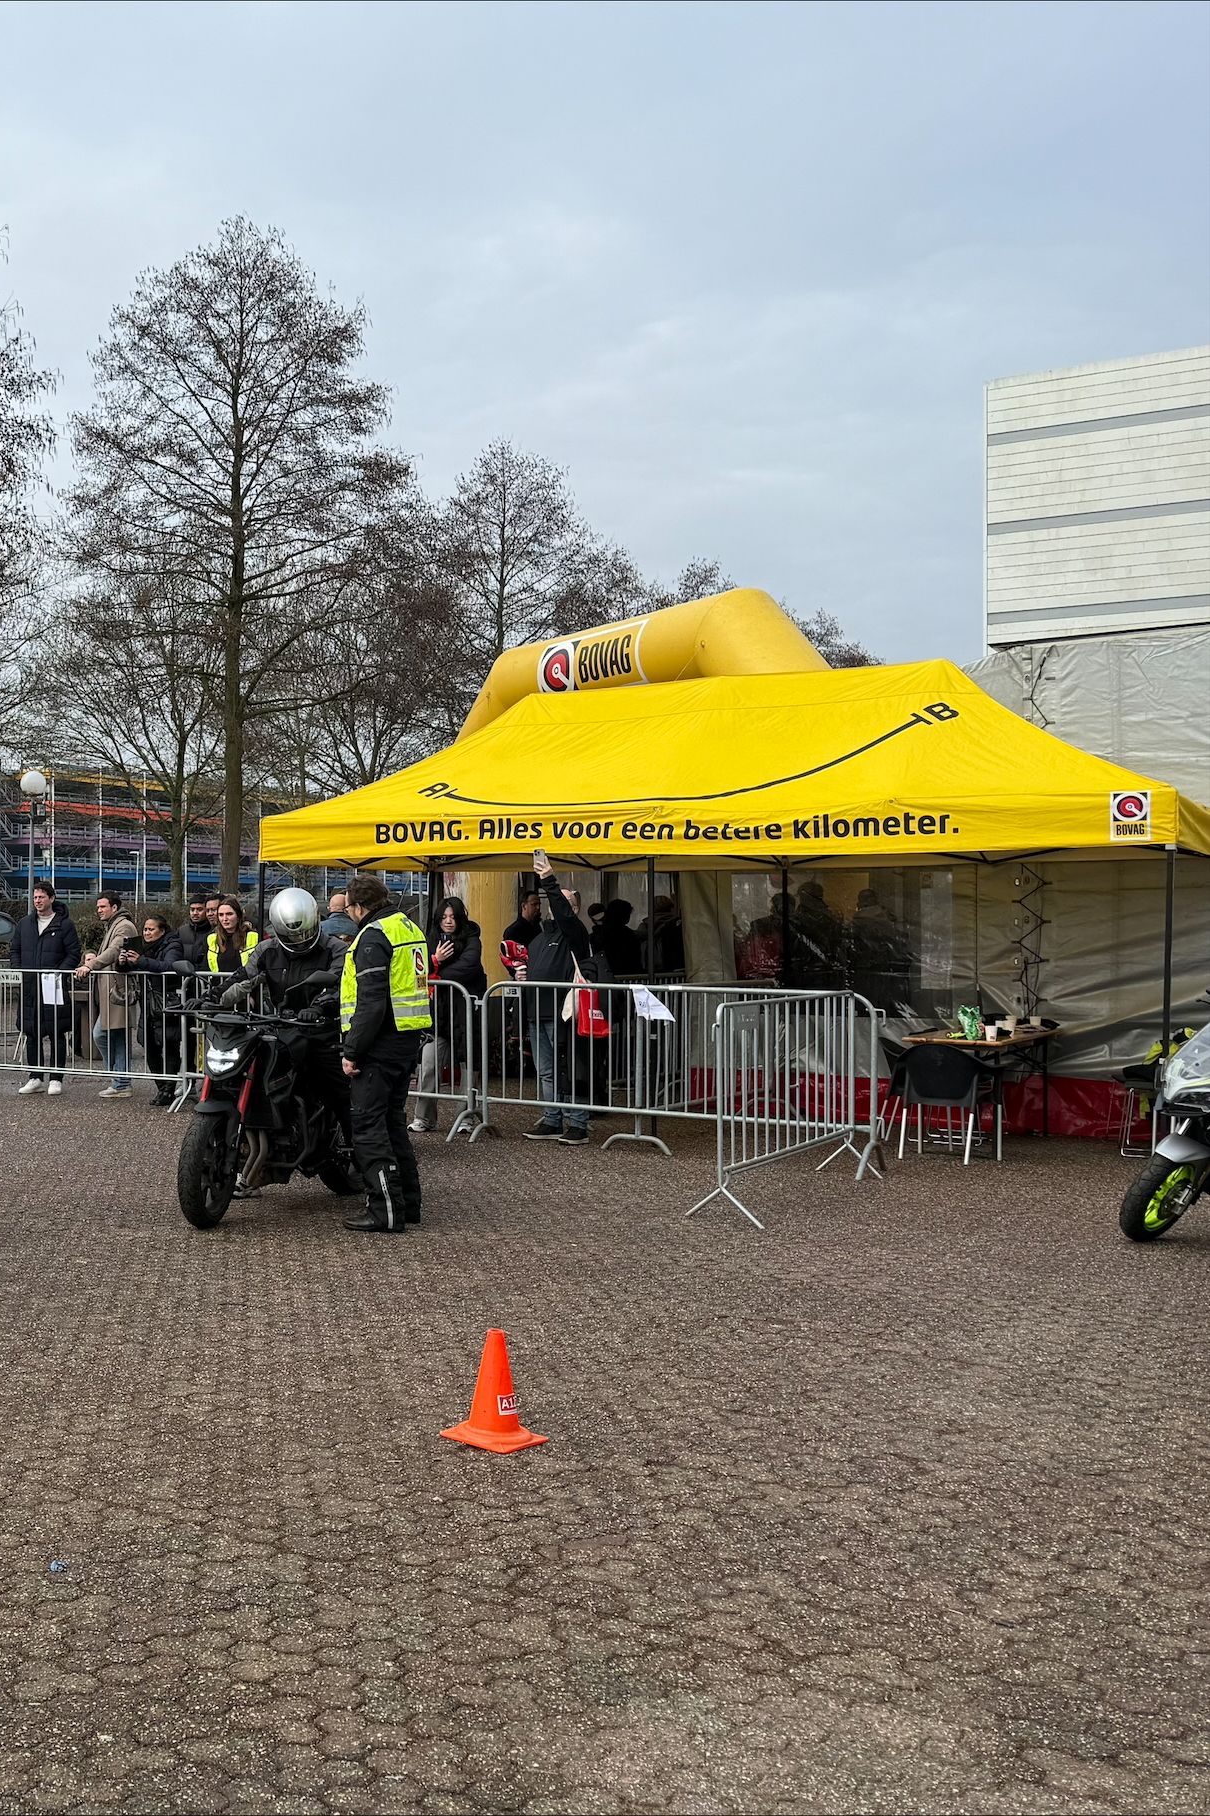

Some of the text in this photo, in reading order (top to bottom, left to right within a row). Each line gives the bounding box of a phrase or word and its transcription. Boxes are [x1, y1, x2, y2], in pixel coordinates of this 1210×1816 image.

[577, 633, 632, 685] BOVAG
[375, 812, 960, 845] BOVAG. Alles voor een betere kilometer.
[1115, 822, 1146, 837] BOVAG
